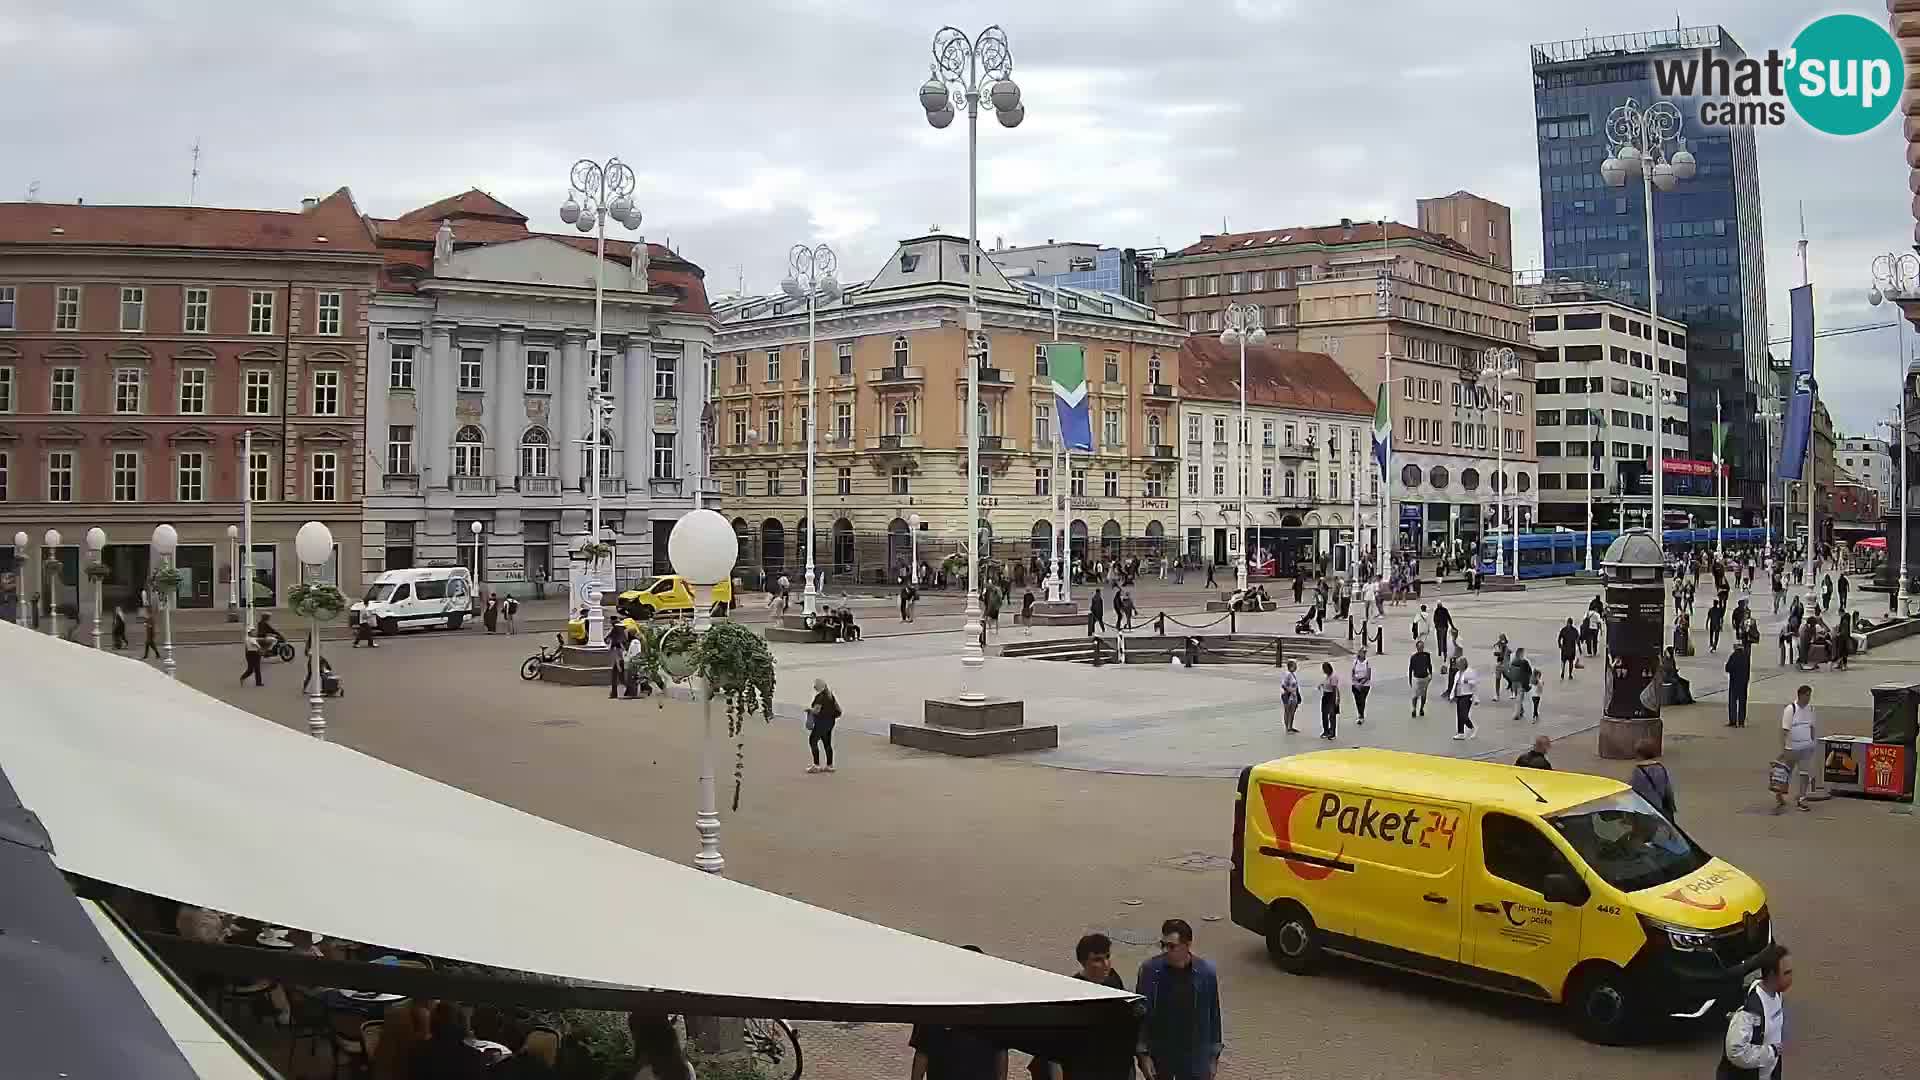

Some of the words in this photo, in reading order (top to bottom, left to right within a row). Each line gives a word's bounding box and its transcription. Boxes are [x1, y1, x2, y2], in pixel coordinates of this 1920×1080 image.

[963, 497, 999, 507] SGER
[1315, 792, 1420, 845] Paket
[1419, 811, 1460, 851] 24
[1596, 904, 1621, 916] 4462
